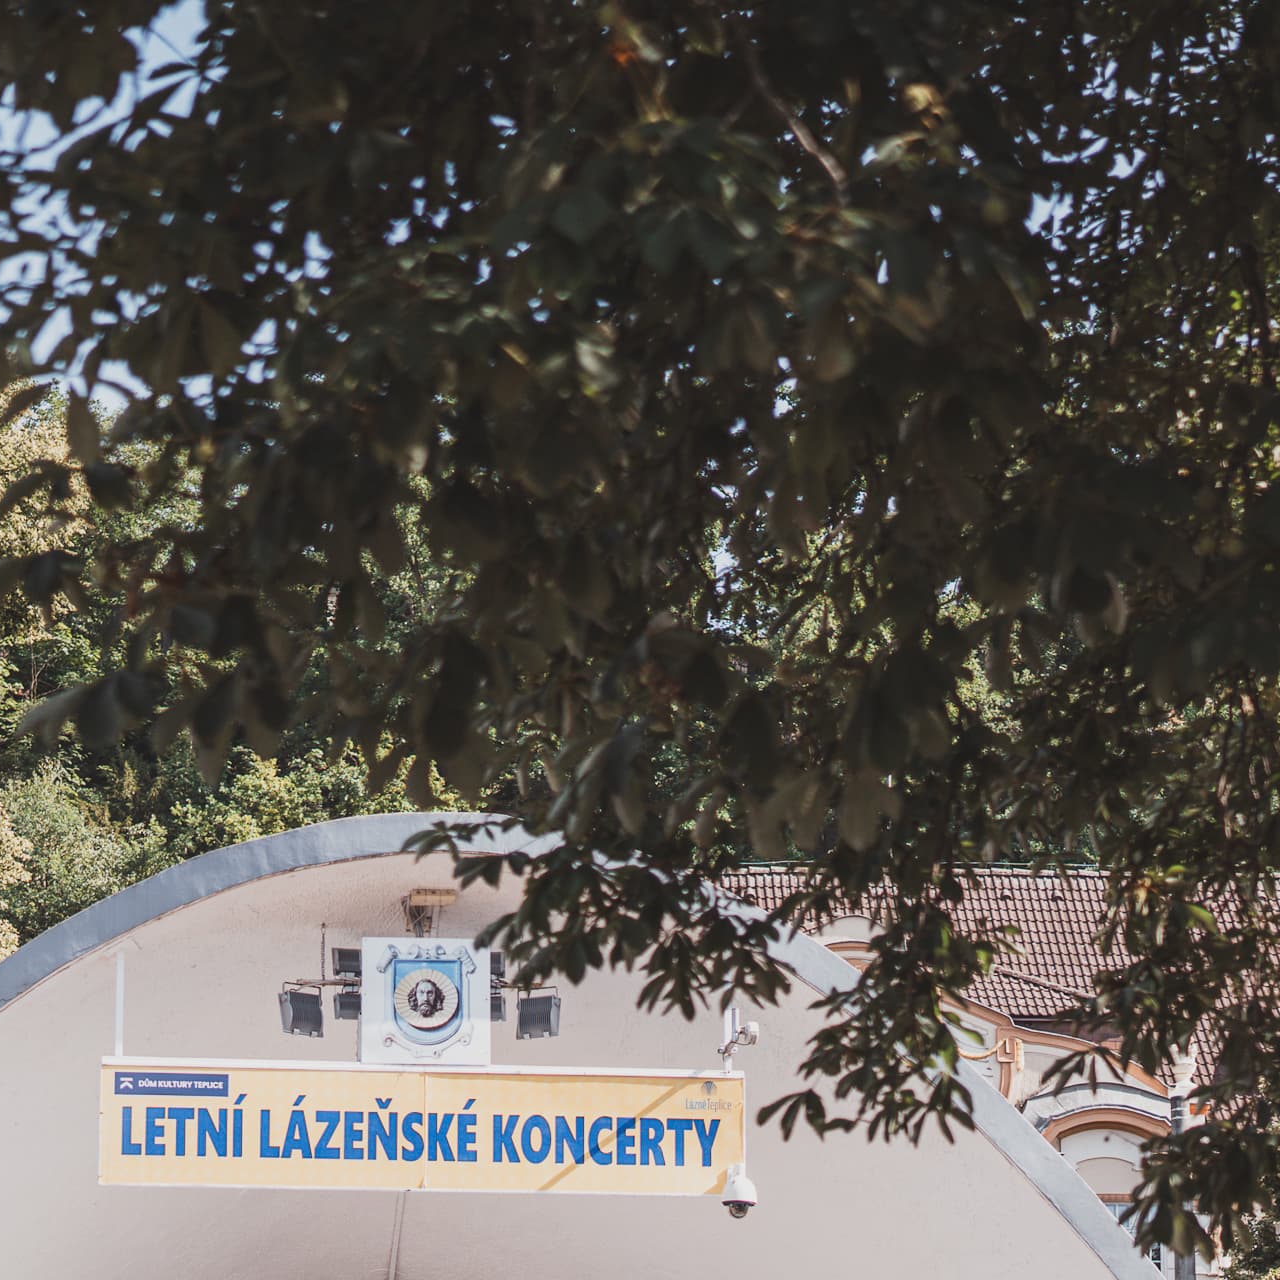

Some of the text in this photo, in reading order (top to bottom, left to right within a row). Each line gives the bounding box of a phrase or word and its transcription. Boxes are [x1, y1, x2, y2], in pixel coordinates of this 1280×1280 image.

[138, 1078, 224, 1089] DŮM KULTURY TEPLICE
[121, 1093, 721, 1168] LETNÍ LÁZEŇSKÉ KONCERTY
